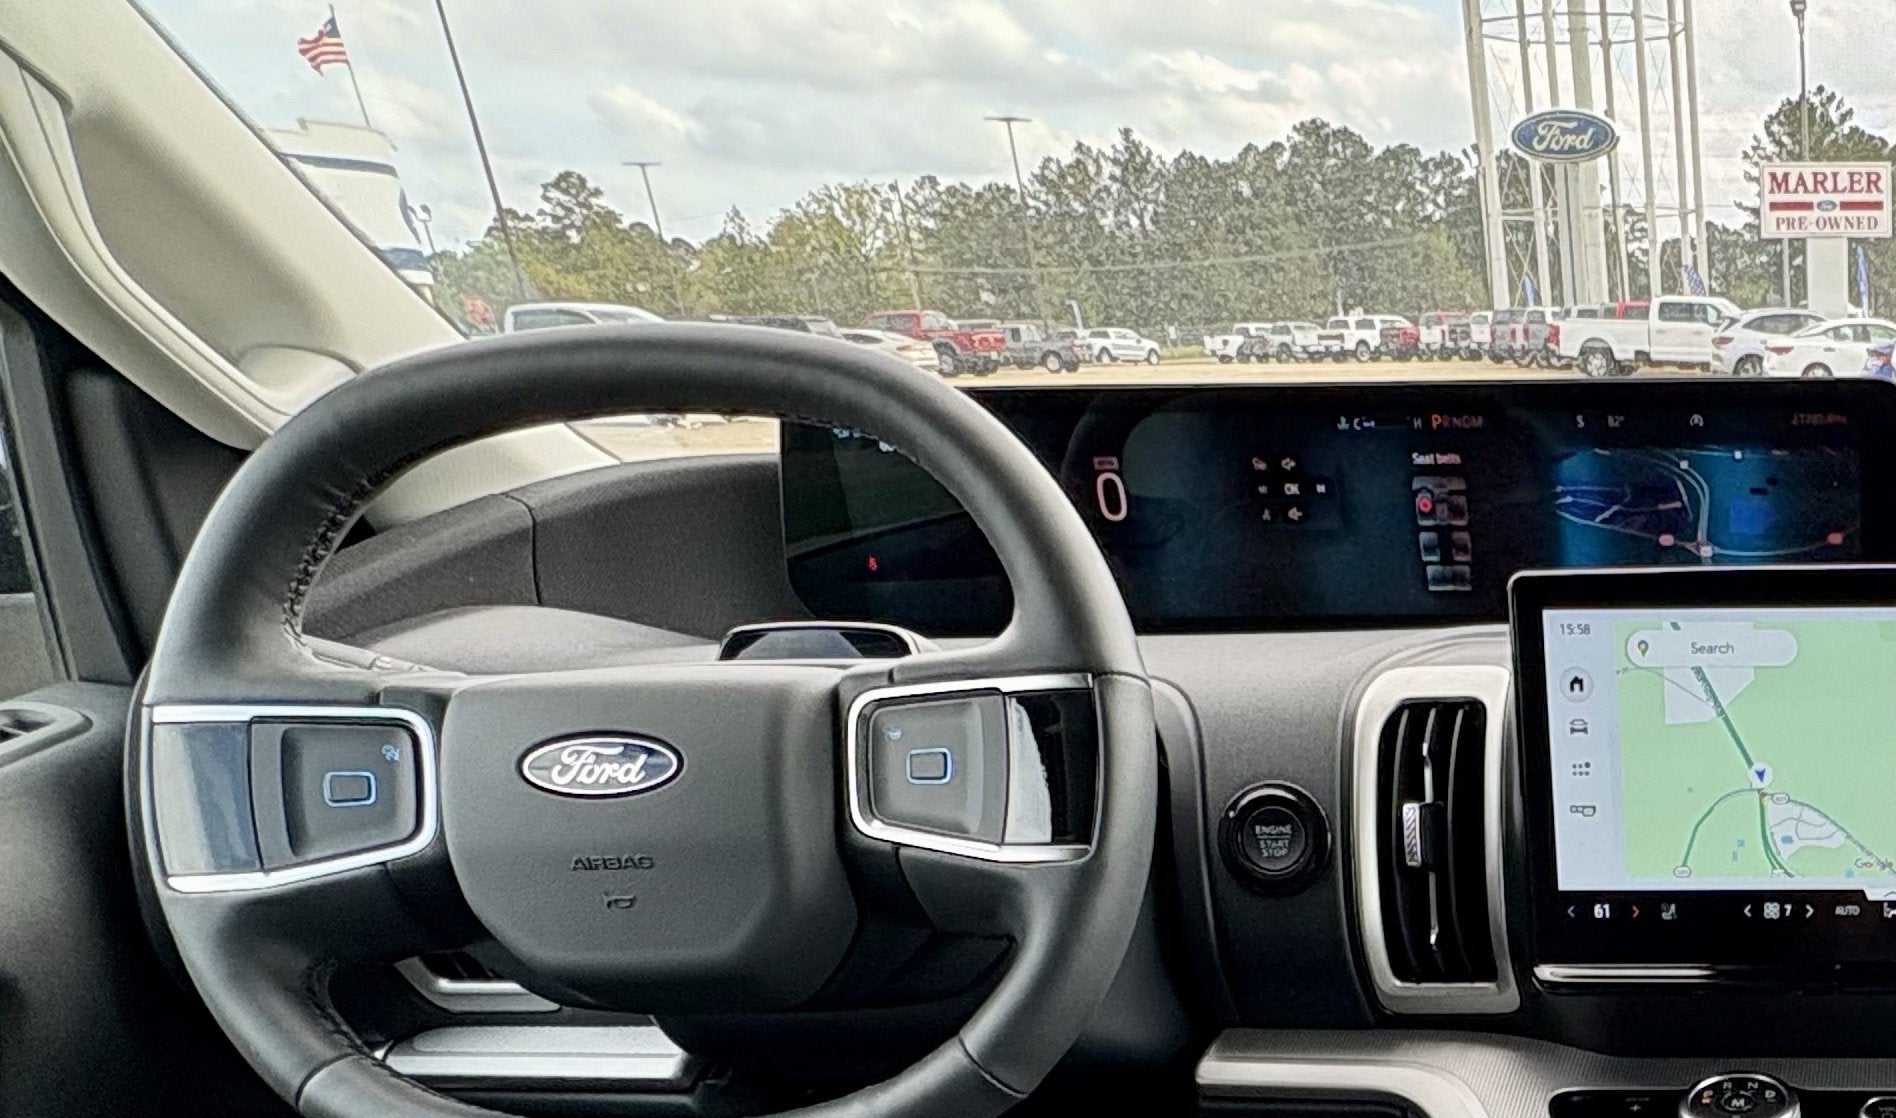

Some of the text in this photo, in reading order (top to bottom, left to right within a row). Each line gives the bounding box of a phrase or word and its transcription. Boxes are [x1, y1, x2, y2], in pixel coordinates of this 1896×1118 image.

[1532, 120, 1597, 151] Ford
[1768, 171, 1884, 194] MARLER
[1775, 215, 1879, 231] PRE-OWNED
[1559, 623, 1591, 636] 15:58
[1690, 640, 1735, 656] Search
[552, 745, 648, 785] Ford
[1259, 839, 1290, 849] START
[1261, 848, 1289, 858] STOP
[571, 856, 655, 872] AIRBAG
[1593, 903, 1611, 919] 61
[1784, 904, 1792, 917] 7
[1834, 904, 1861, 916] AUTO
[1722, 1081, 1733, 1090] R
[1747, 1081, 1759, 1090] N
[1764, 1089, 1777, 1099] D
[1731, 1098, 1746, 1107] M
